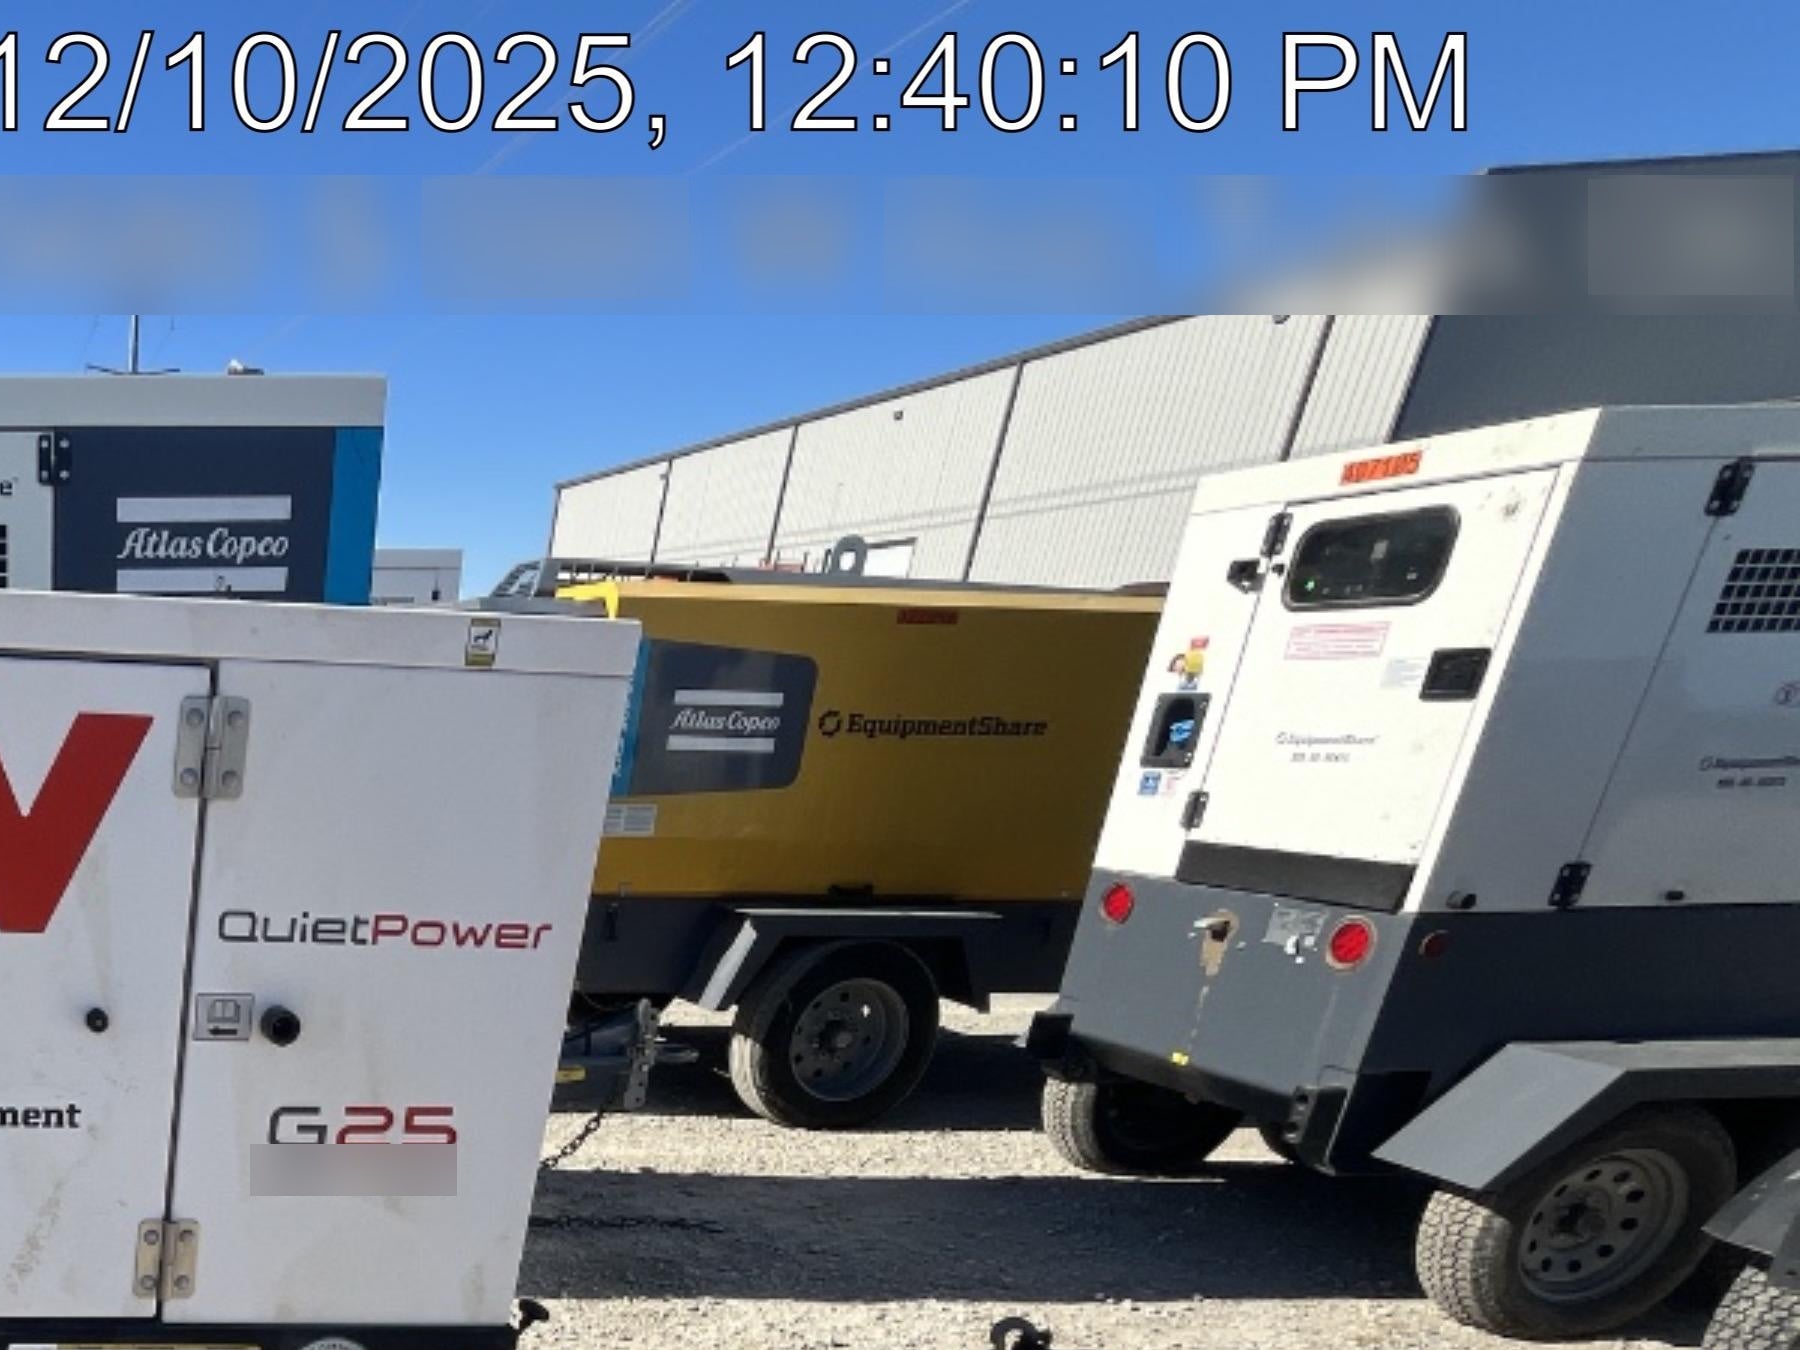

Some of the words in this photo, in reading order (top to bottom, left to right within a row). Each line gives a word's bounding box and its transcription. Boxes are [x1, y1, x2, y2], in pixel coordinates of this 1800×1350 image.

[116, 527, 204, 560] Atlas
[206, 527, 290, 565] Copco
[669, 707, 727, 730] Atlas
[727, 709, 781, 735] Copco
[845, 713, 1048, 738] EquipmentShare
[217, 908, 553, 950] QuietPower
[267, 1105, 458, 1145] G25
